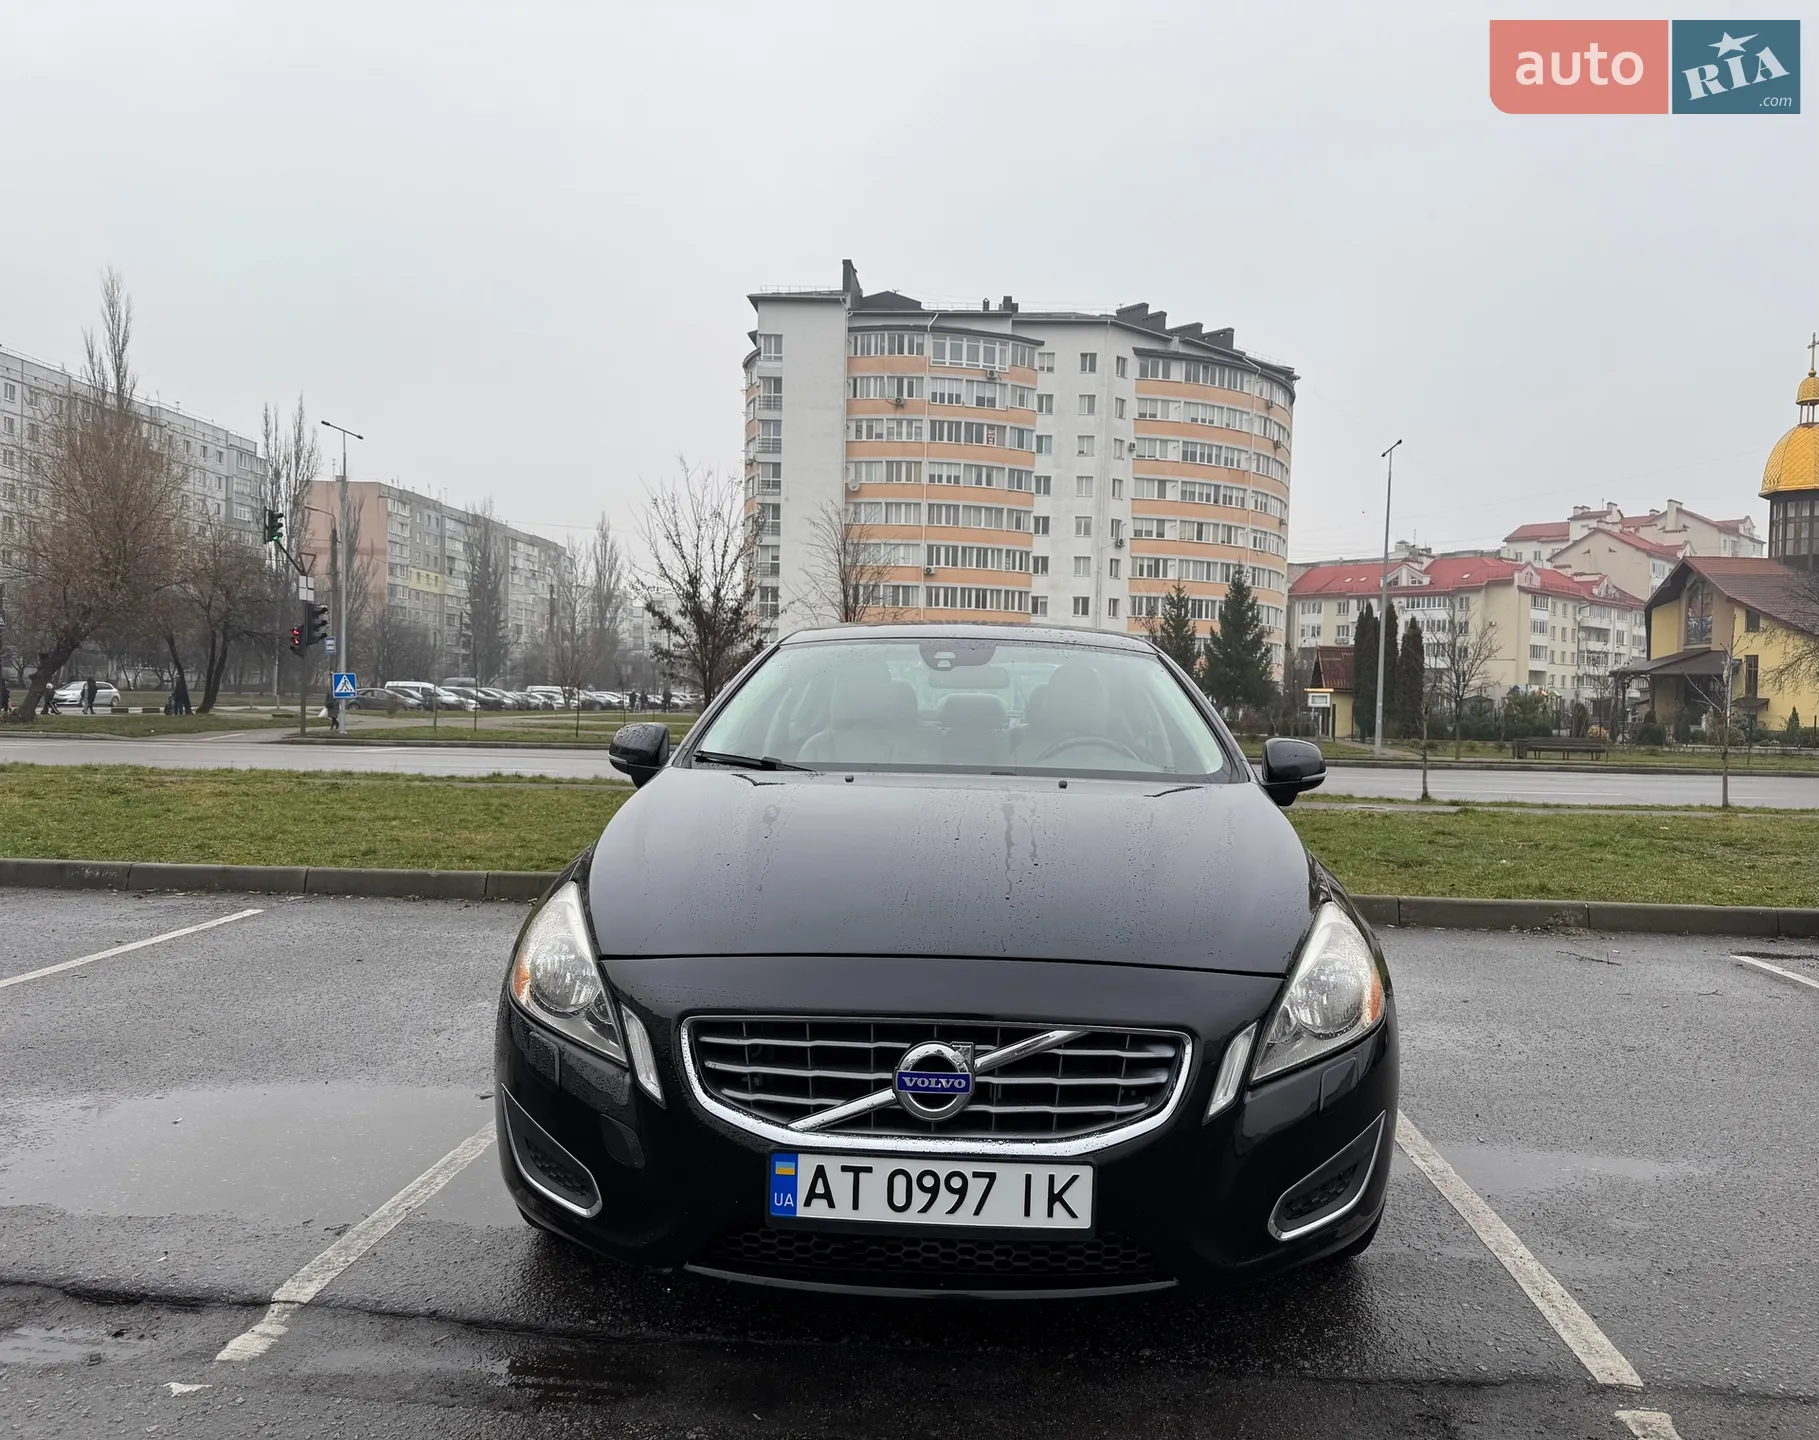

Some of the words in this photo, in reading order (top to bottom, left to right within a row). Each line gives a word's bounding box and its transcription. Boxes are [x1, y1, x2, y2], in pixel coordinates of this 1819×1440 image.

[902, 1076, 966, 1089] VOLVO
[803, 1164, 873, 1211] AT
[886, 1168, 997, 1216] 0997
[1023, 1173, 1081, 1219] IK
[774, 1192, 794, 1207] UA
